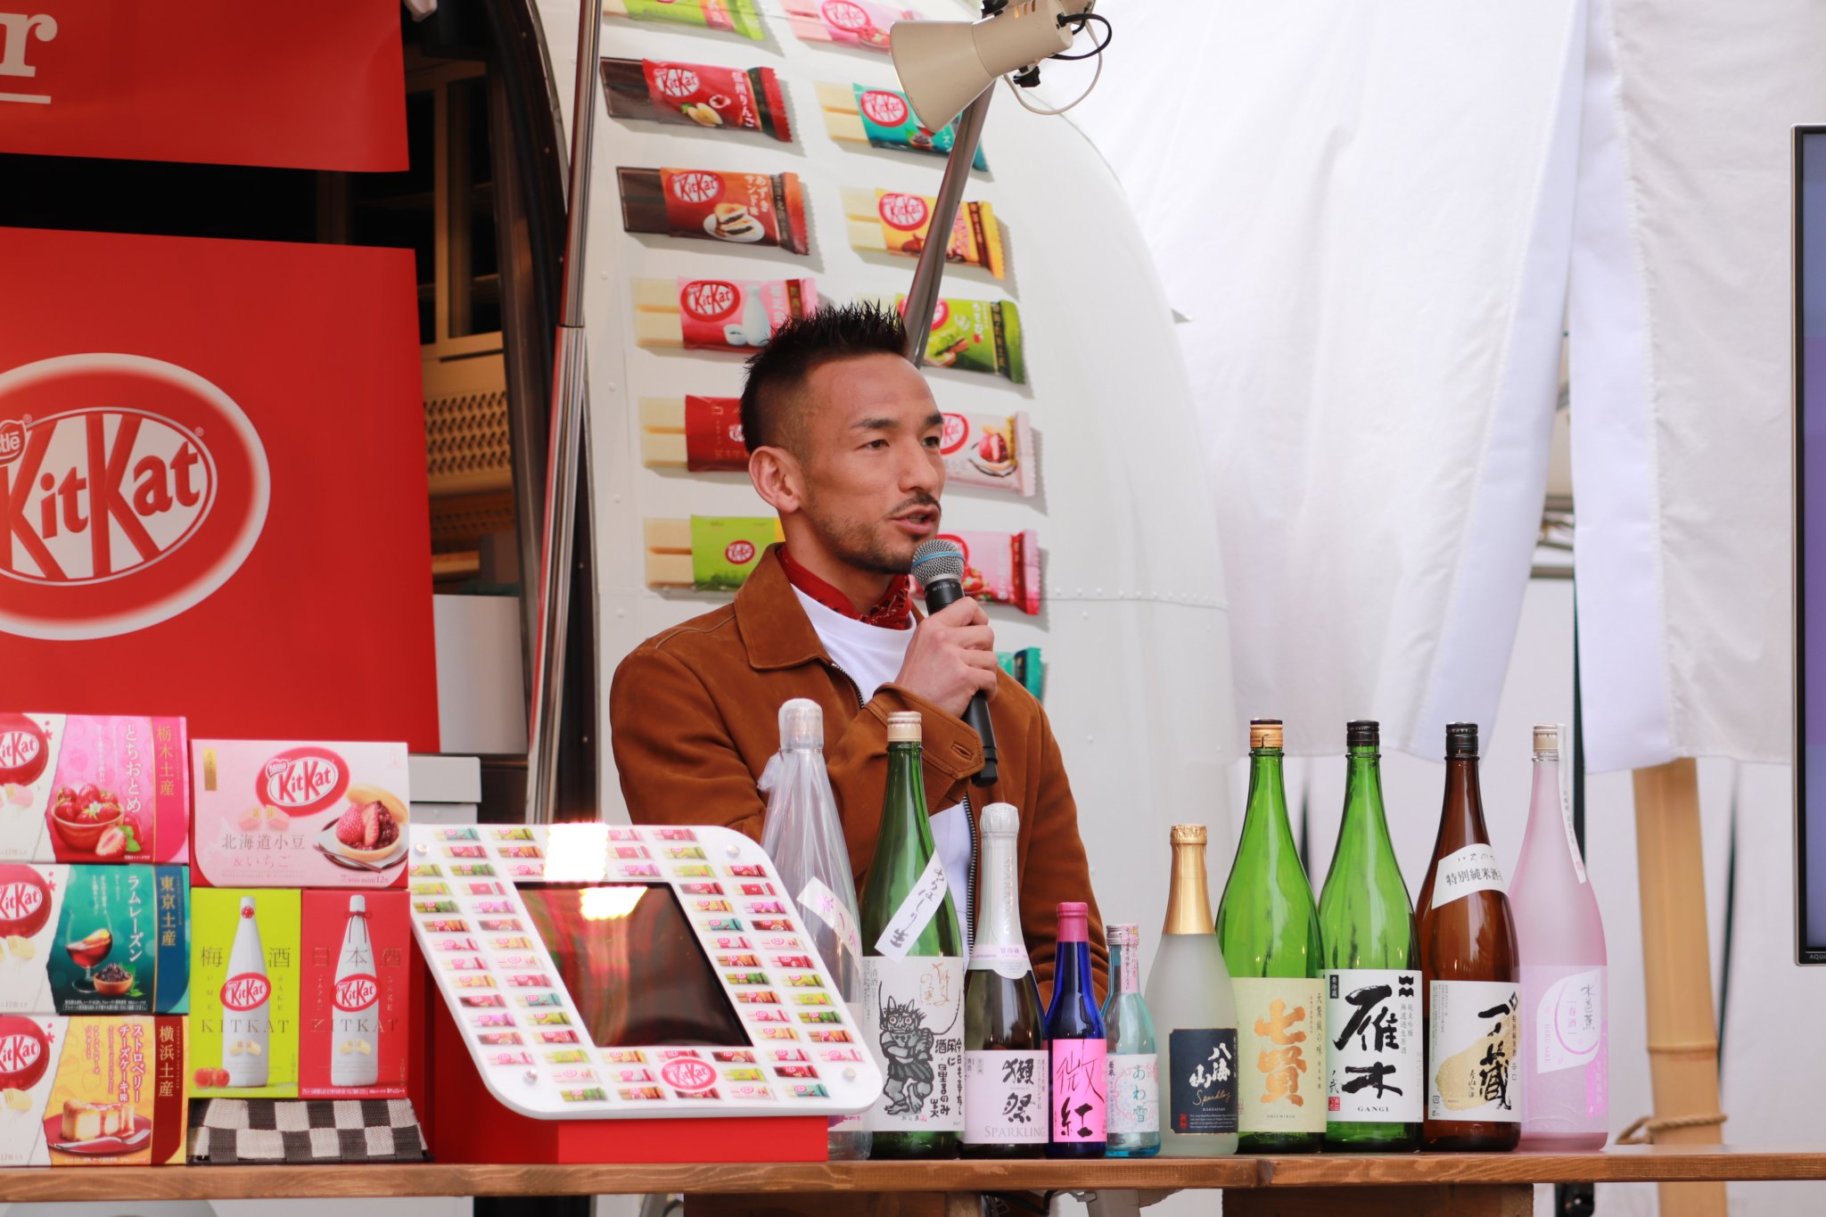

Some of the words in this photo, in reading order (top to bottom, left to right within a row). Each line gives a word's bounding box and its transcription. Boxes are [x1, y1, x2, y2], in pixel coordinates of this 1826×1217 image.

[679, 174, 718, 202] KitKat
[693, 285, 734, 315] KitKat
[0, 413, 200, 580] KitKat
[126, 725, 142, 813] とちおとめ
[157, 727, 175, 796] 栃木土産
[278, 761, 331, 803] KitKat
[222, 833, 305, 851] 北海道小豆
[128, 875, 144, 962] ラムレーズン
[160, 875, 177, 947] 東京土産
[201, 947, 291, 969] 梅酒
[231, 981, 264, 1006] KitKat
[341, 981, 374, 1007] KitKat
[201, 1018, 289, 1033] KITKAT
[1332, 983, 1404, 1100] 雁木
[158, 1026, 175, 1098] 横浜土産
[1189, 1042, 1232, 1089] 八海山
[1478, 1003, 1512, 1112] 一ノ蔵
[1002, 1058, 1035, 1123] 獺祭
[1055, 1042, 1106, 1139] 微紅
[1132, 1063, 1149, 1124] あわ雪
[1357, 1105, 1391, 1113] GANGI
[984, 1126, 1046, 1139] SPARKLING
